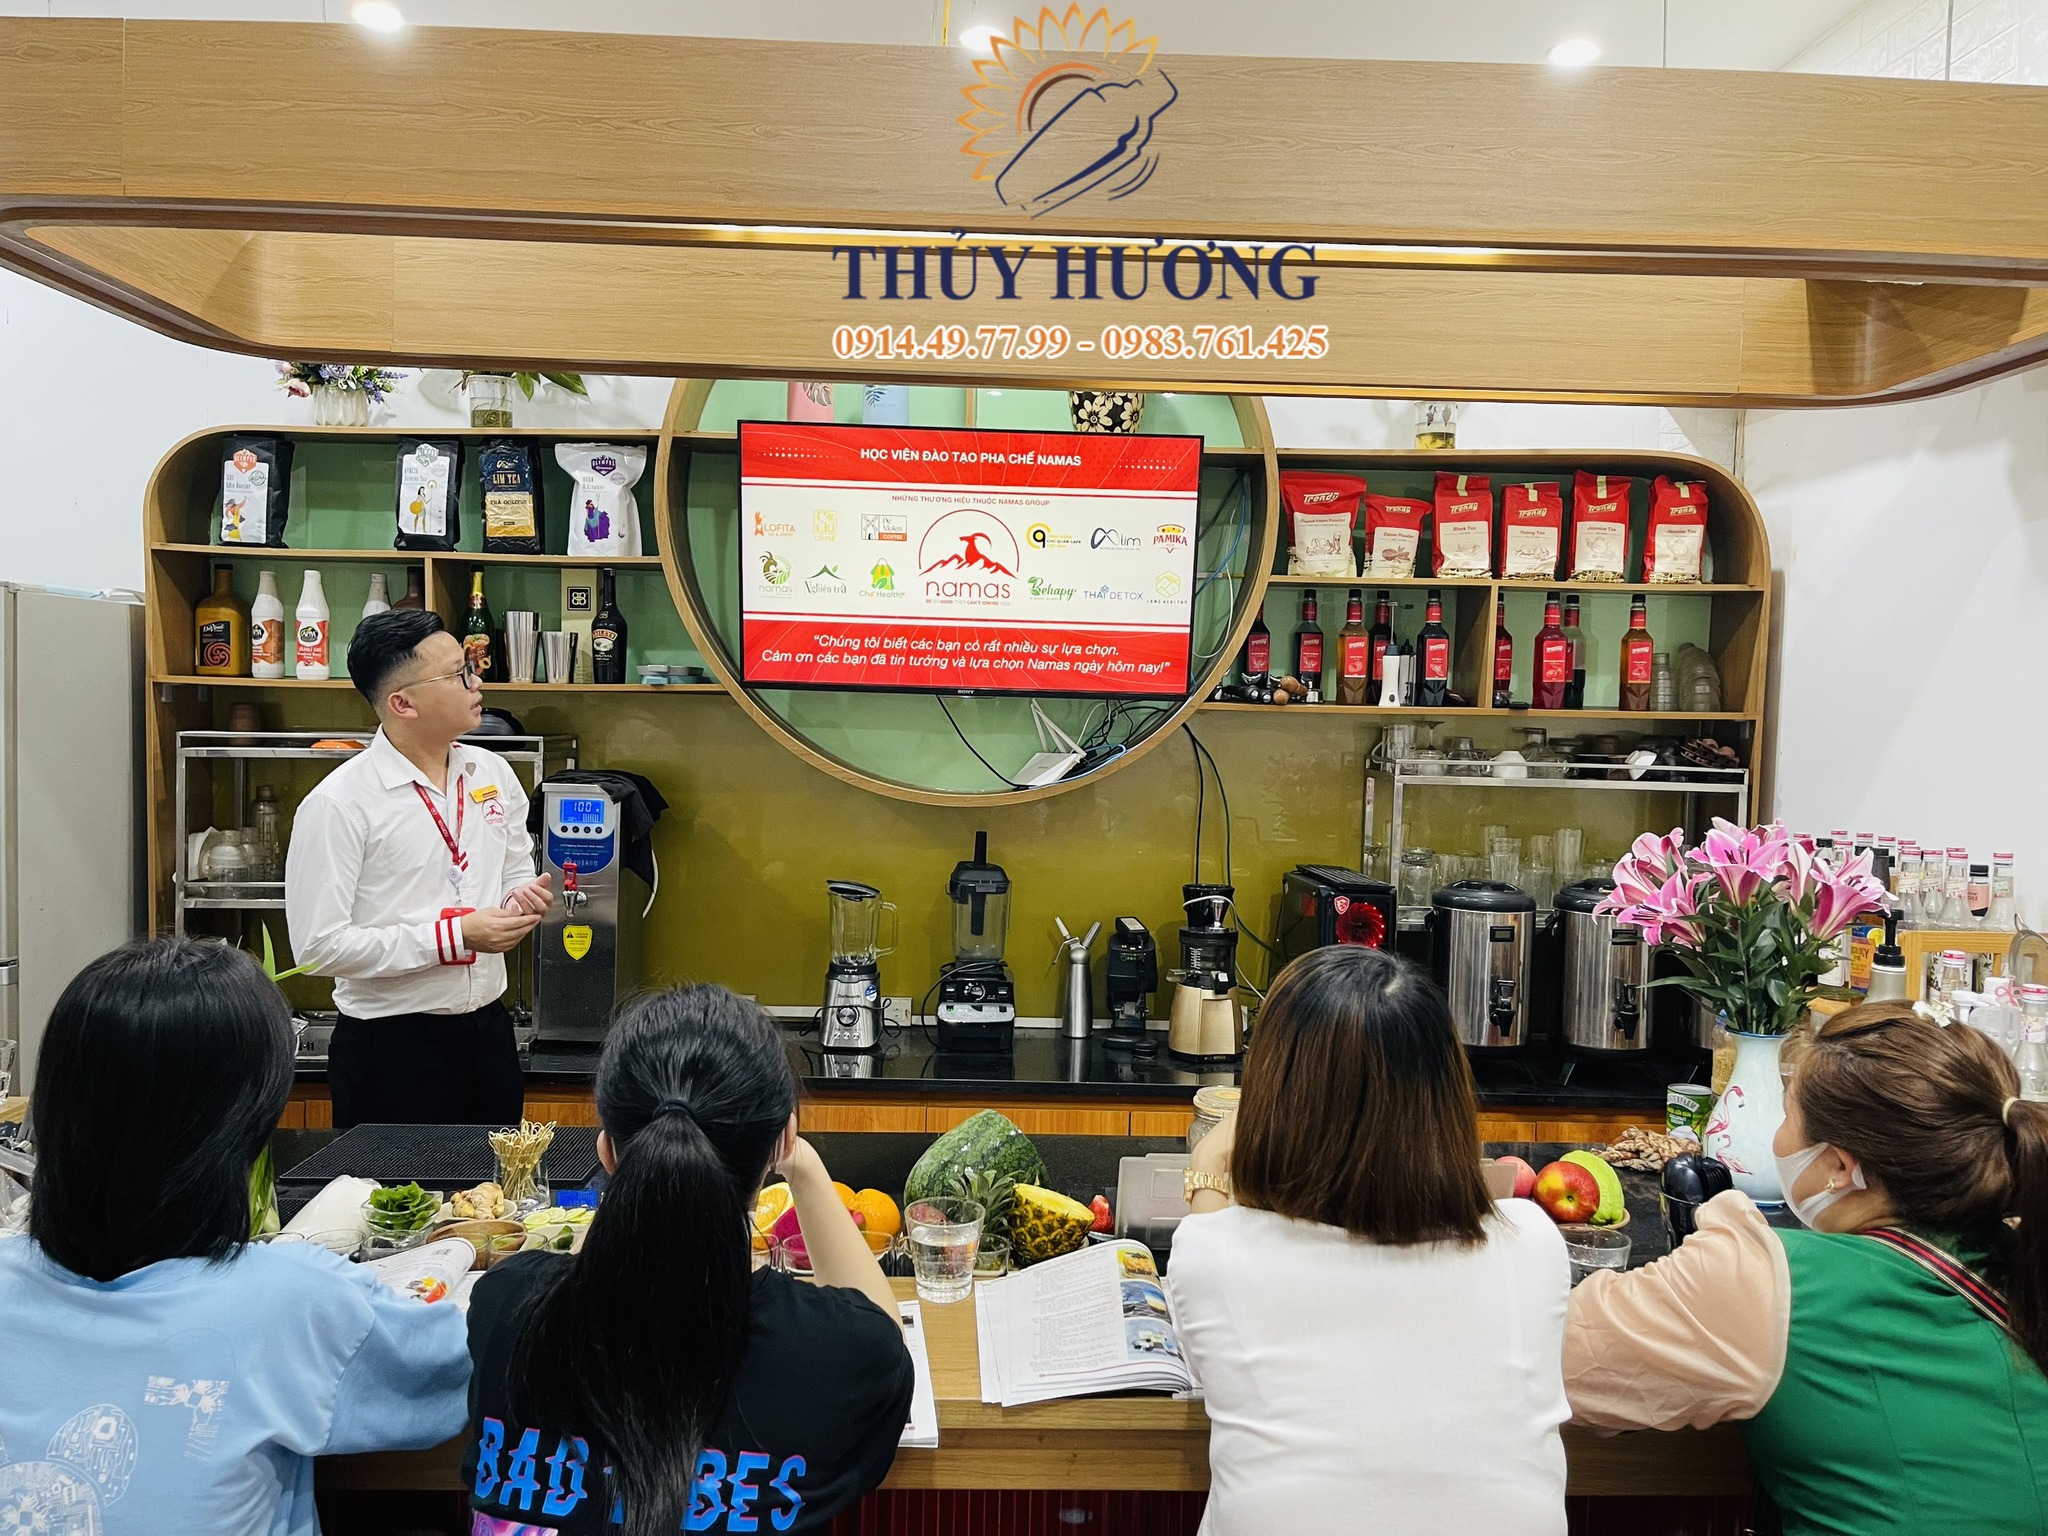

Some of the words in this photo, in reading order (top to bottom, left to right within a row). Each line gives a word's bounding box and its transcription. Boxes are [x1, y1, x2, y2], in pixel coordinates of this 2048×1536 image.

[860, 448, 888, 461] HỌC
[890, 447, 919, 463] VIỆN
[922, 449, 949, 462] ĐÀO
[952, 451, 978, 465] TẠO
[980, 453, 1006, 464] PHA
[1008, 451, 1035, 465] CHẾ
[1037, 455, 1082, 466] NAMAS
[1304, 492, 1340, 505] Trendy
[1450, 502, 1478, 514] Trendy
[1519, 508, 1548, 519] Trendy
[1588, 503, 1617, 513] Trendy
[1153, 534, 1188, 547] PAMIKA
[926, 580, 1011, 599] namas
[1109, 592, 1144, 600] DETOX
[864, 636, 881, 649] tôi
[911, 638, 934, 650] các
[936, 639, 960, 653] bạn
[964, 640, 980, 651] có
[1062, 642, 1082, 655] lựa
[1085, 643, 1120, 657] chọn.
[762, 649, 792, 662] Cảm
[795, 653, 813, 663] ơn
[817, 652, 839, 664] các
[842, 653, 867, 666] bạn
[870, 653, 887, 665] đã
[890, 653, 906, 666] tin
[952, 656, 966, 668] và
[969, 656, 990, 669] lựa
[993, 657, 1024, 672] chọn
[1027, 658, 1071, 671] Namas
[1073, 660, 1104, 675] ngày
[1106, 660, 1134, 673] hôm
[474, 1416, 590, 1516] BAD
